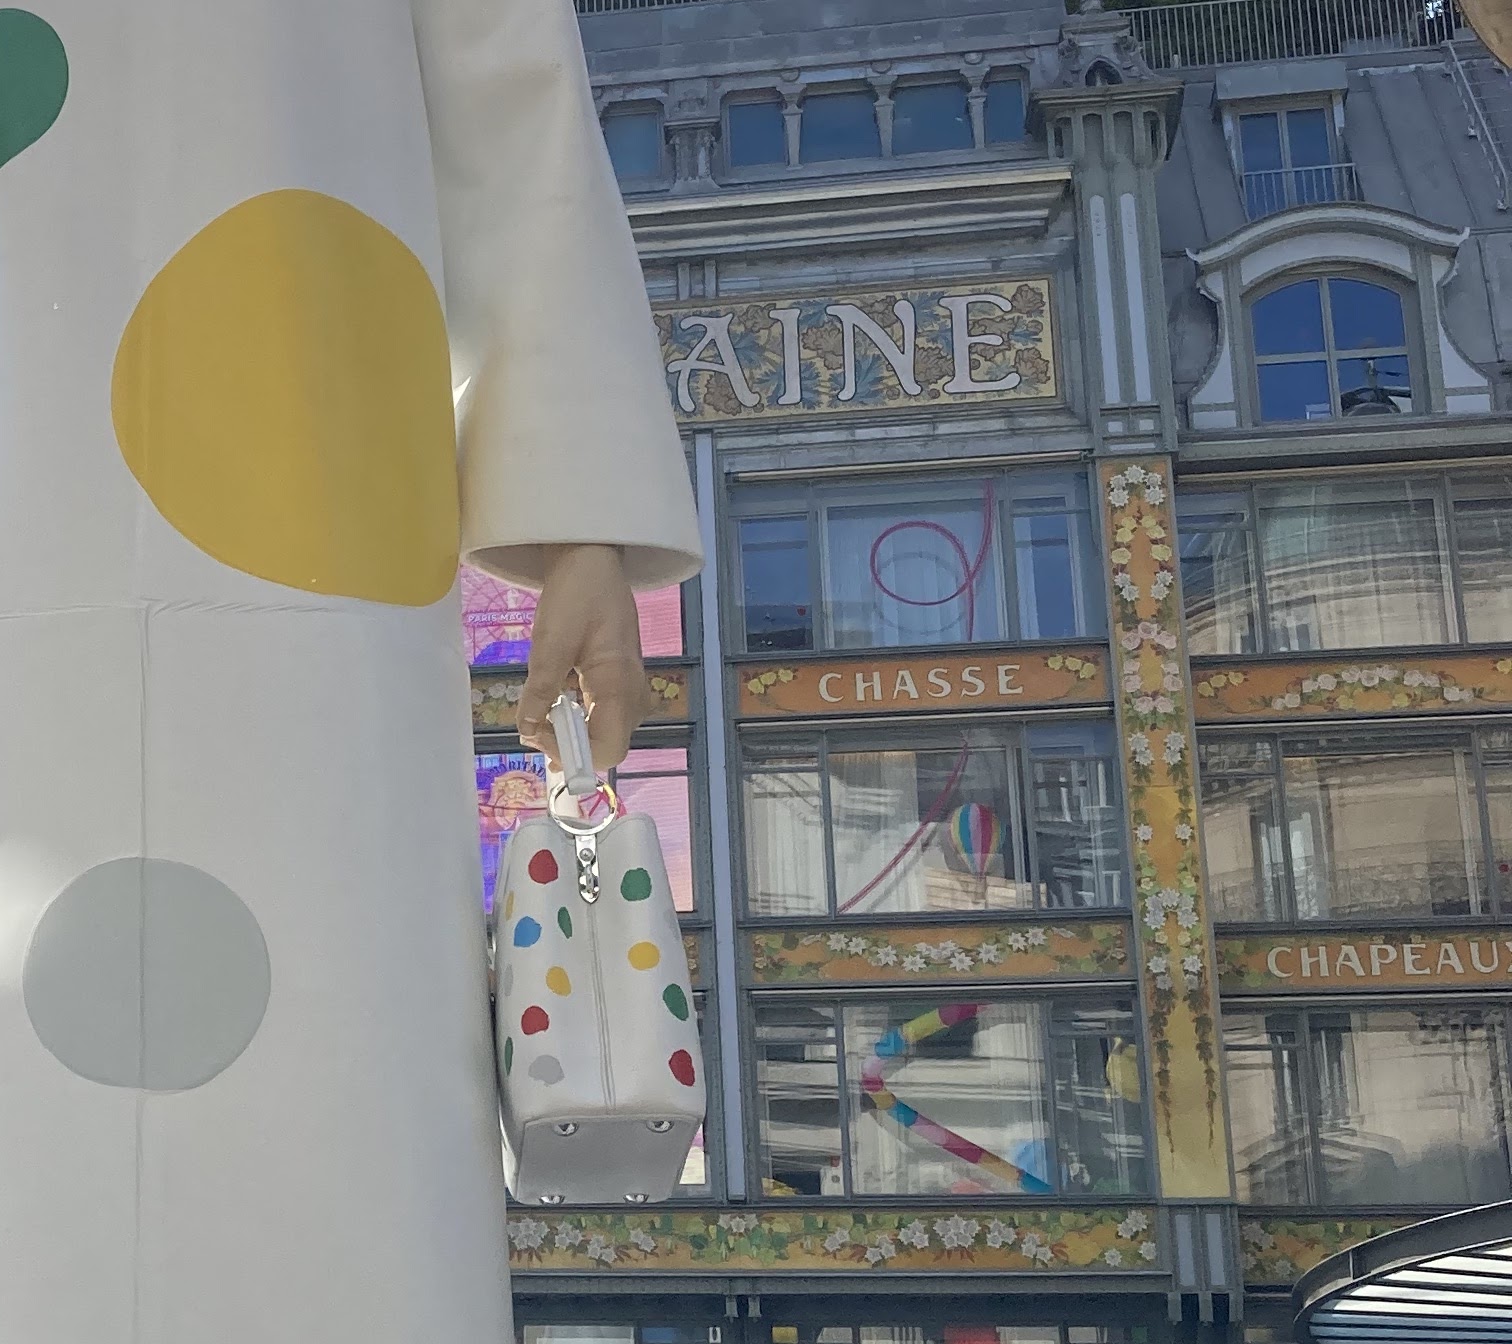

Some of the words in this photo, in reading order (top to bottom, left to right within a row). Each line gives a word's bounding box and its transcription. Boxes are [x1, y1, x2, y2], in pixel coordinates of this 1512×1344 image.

[666, 292, 1022, 413] AINE
[468, 613, 498, 624] PARIS
[818, 664, 1024, 703] CHASSE
[1267, 939, 1512, 978] CHAPEAU
